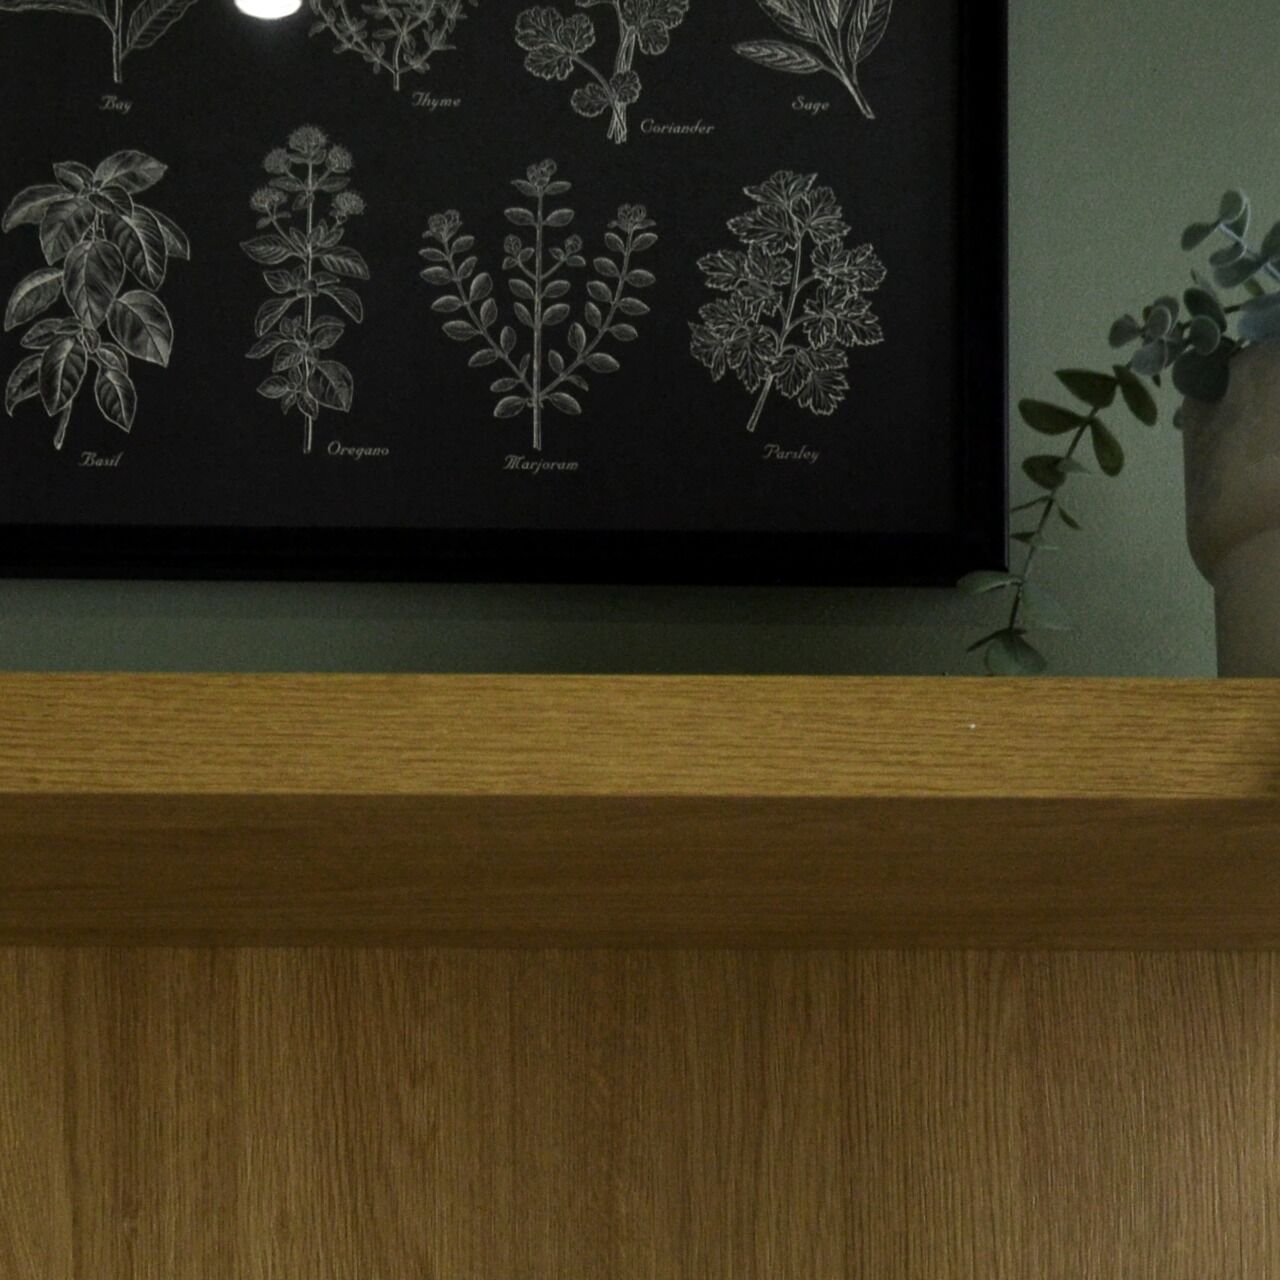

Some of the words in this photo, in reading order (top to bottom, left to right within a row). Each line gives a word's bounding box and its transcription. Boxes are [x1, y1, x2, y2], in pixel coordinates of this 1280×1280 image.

[99, 94, 133, 114] Bay
[411, 92, 462, 111] Thyme
[792, 96, 830, 115] Sage
[640, 118, 715, 134] Coriander
[78, 451, 124, 467] Basil
[327, 440, 390, 460] Oregano
[762, 443, 820, 464] Parsley
[503, 455, 579, 474] Marjoram
